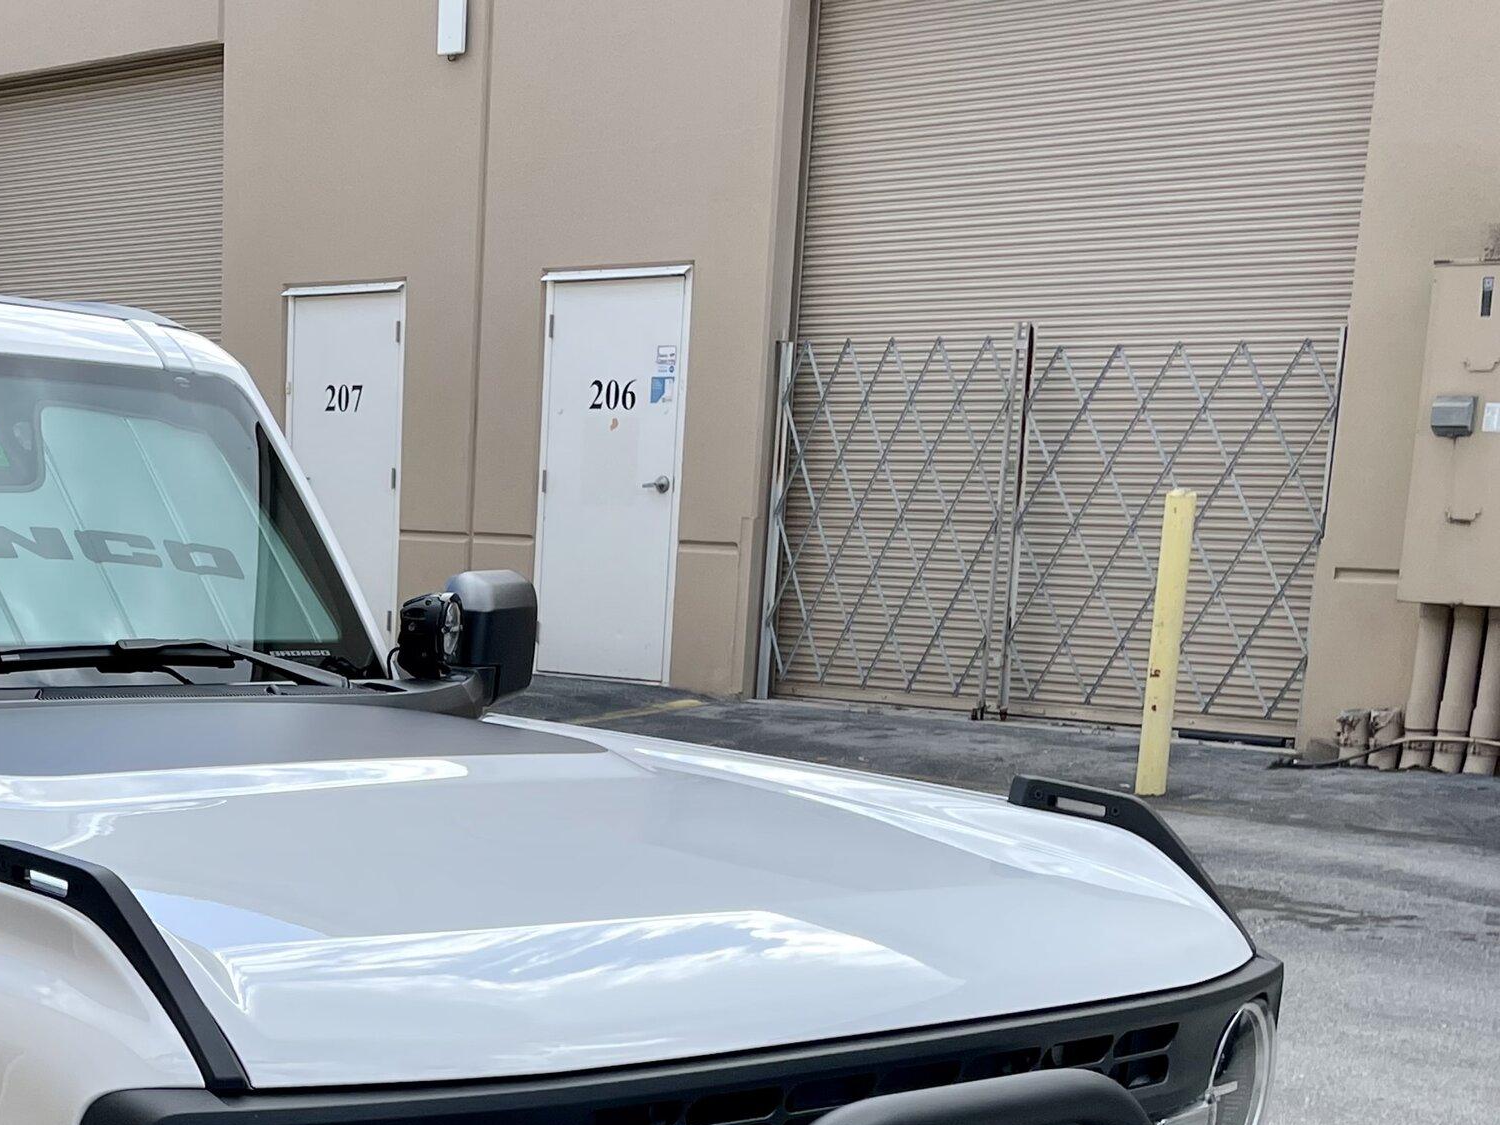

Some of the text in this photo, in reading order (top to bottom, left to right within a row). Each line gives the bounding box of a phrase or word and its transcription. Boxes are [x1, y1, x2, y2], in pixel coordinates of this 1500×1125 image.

[324, 384, 363, 412] 207
[589, 379, 637, 410] 206
[269, 649, 331, 657] BRONCO
